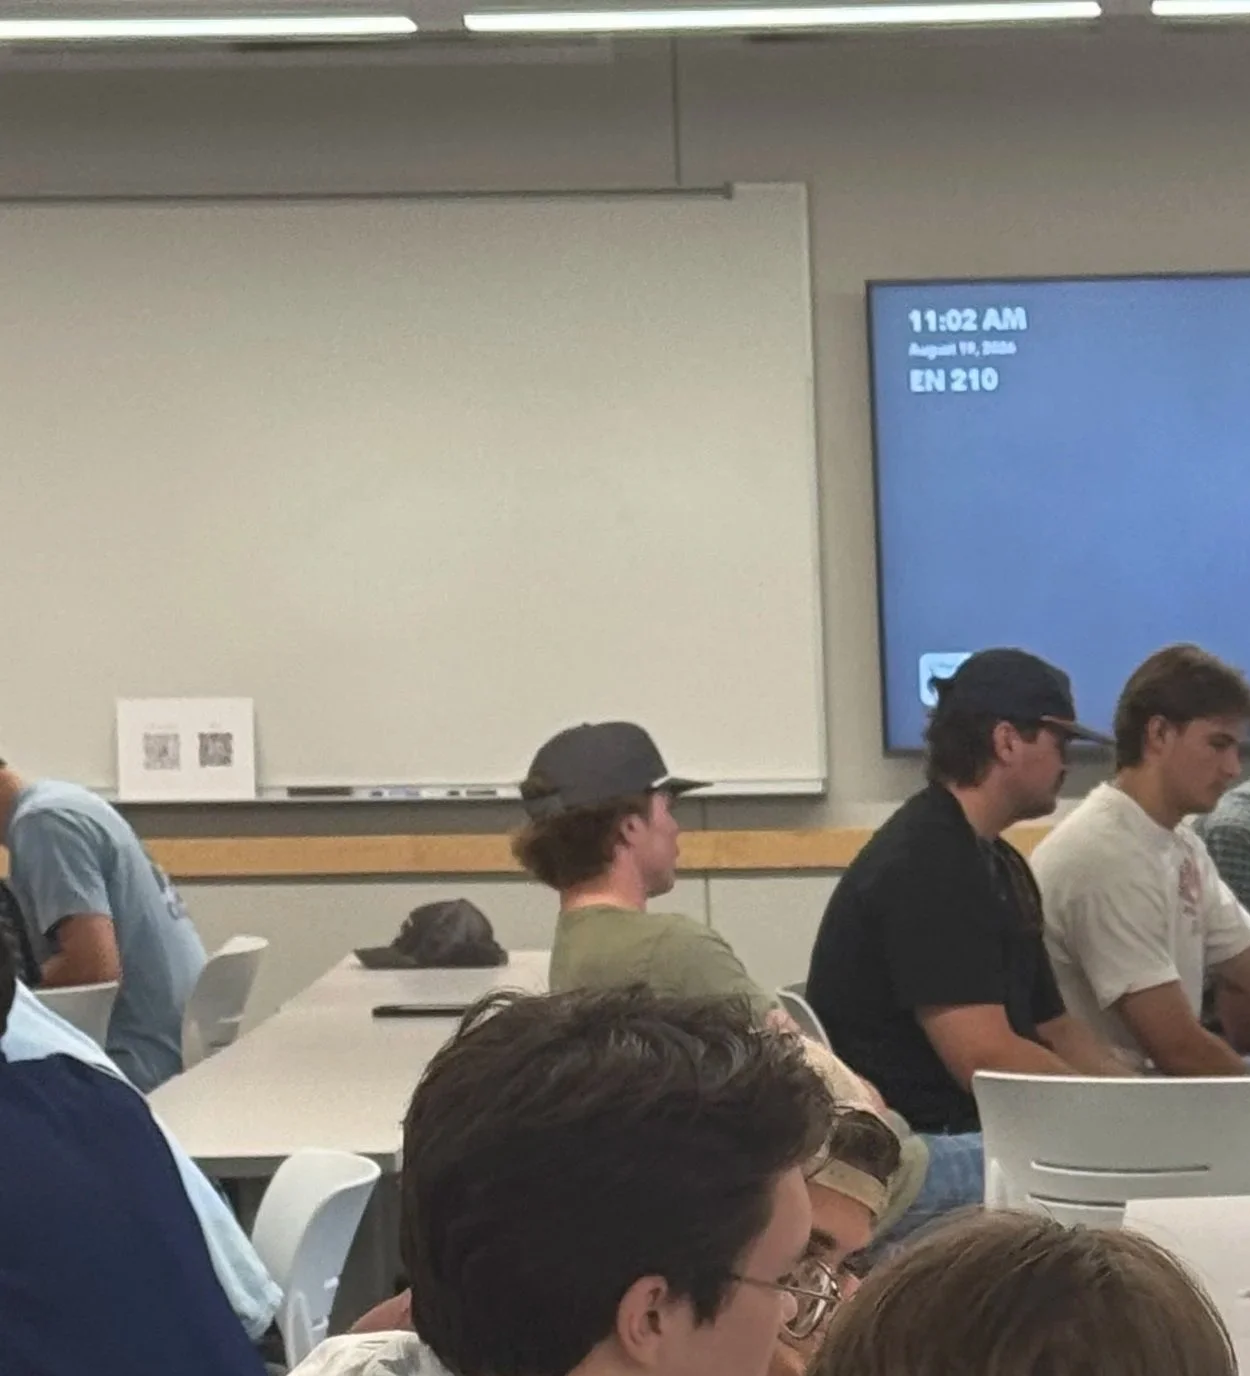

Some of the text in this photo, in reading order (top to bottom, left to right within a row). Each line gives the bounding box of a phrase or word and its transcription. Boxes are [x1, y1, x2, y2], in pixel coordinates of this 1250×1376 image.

[908, 306, 1028, 333] 11:02 AM
[909, 367, 999, 392] EN 210
